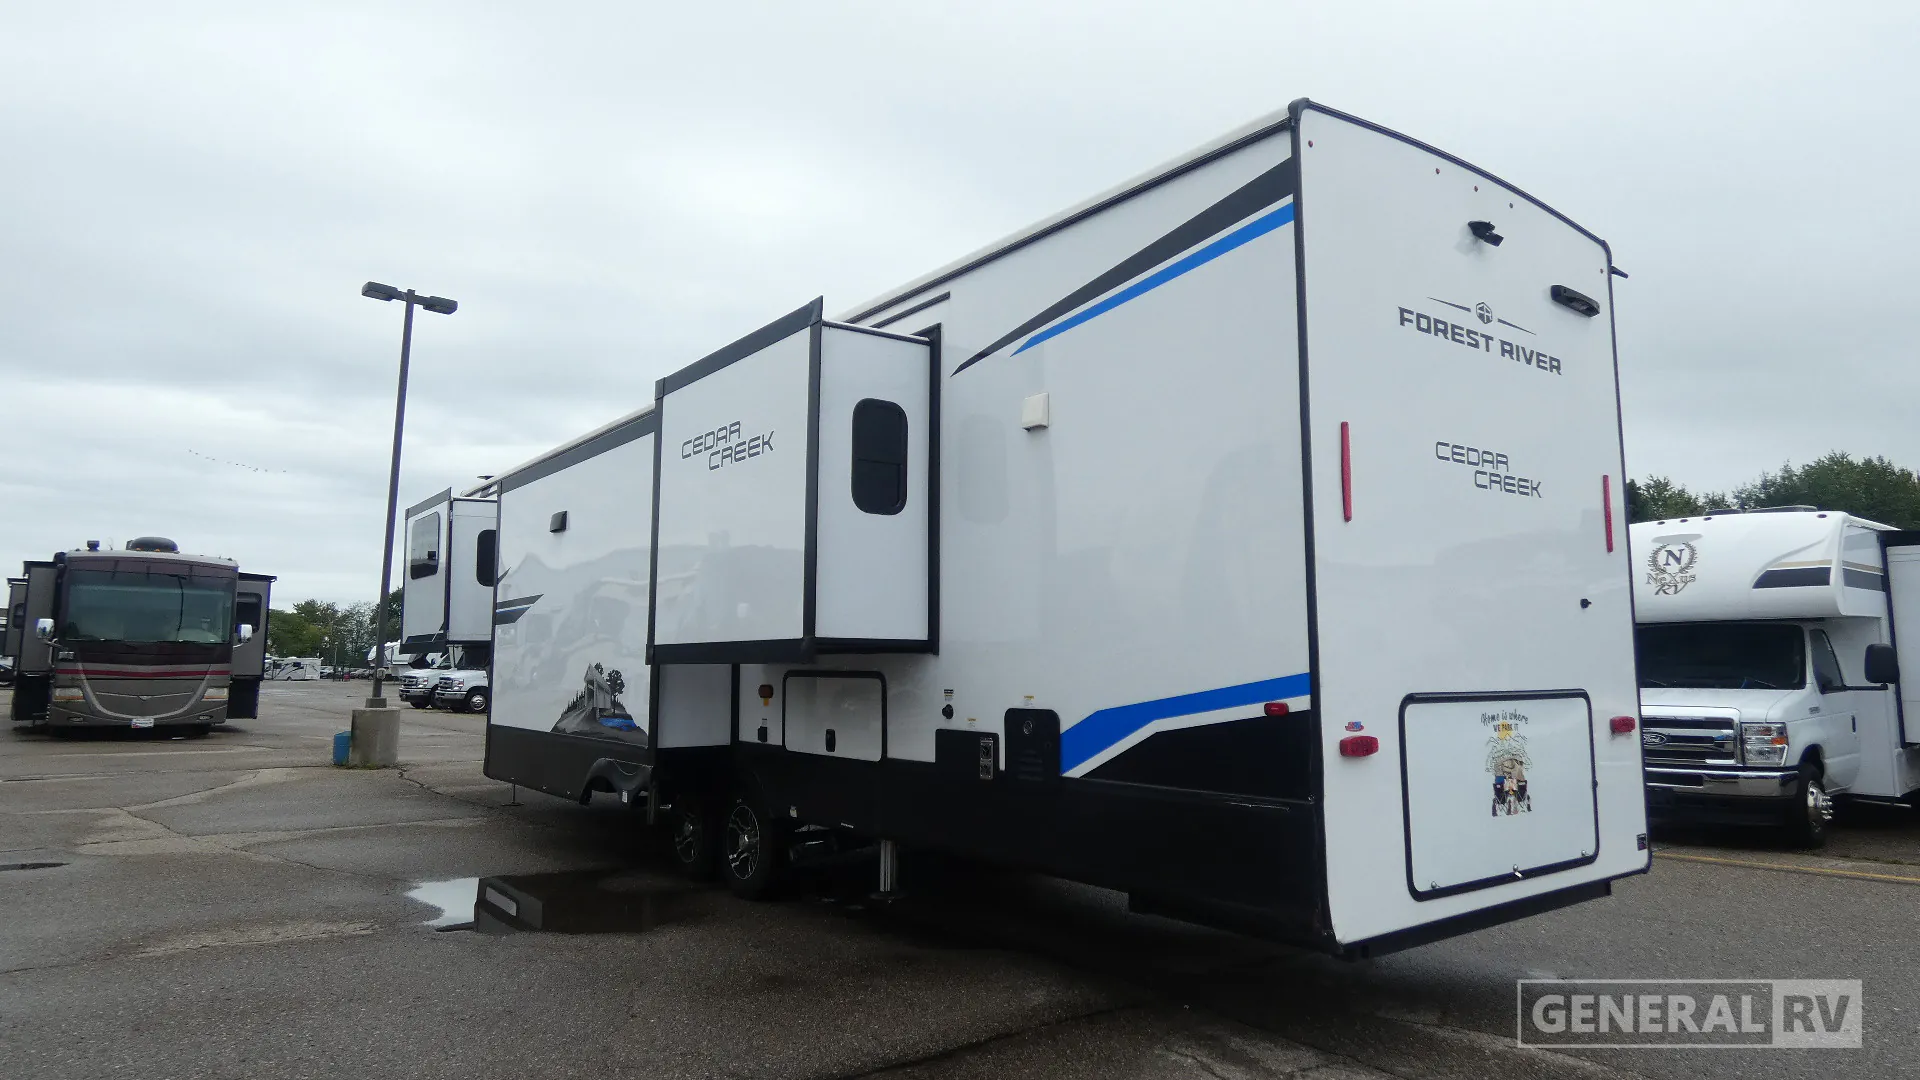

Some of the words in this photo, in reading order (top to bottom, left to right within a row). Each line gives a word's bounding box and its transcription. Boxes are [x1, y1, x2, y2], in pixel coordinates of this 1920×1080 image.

[1398, 306, 1494, 353] FOREST
[1499, 339, 1562, 376] RIVER
[681, 420, 741, 460] CEDAR
[708, 430, 775, 471] CREEK
[1435, 441, 1510, 473] CEDAR
[1474, 470, 1542, 499] CREEK
[1663, 548, 1685, 567] N
[1508, 708, 1529, 725] where
